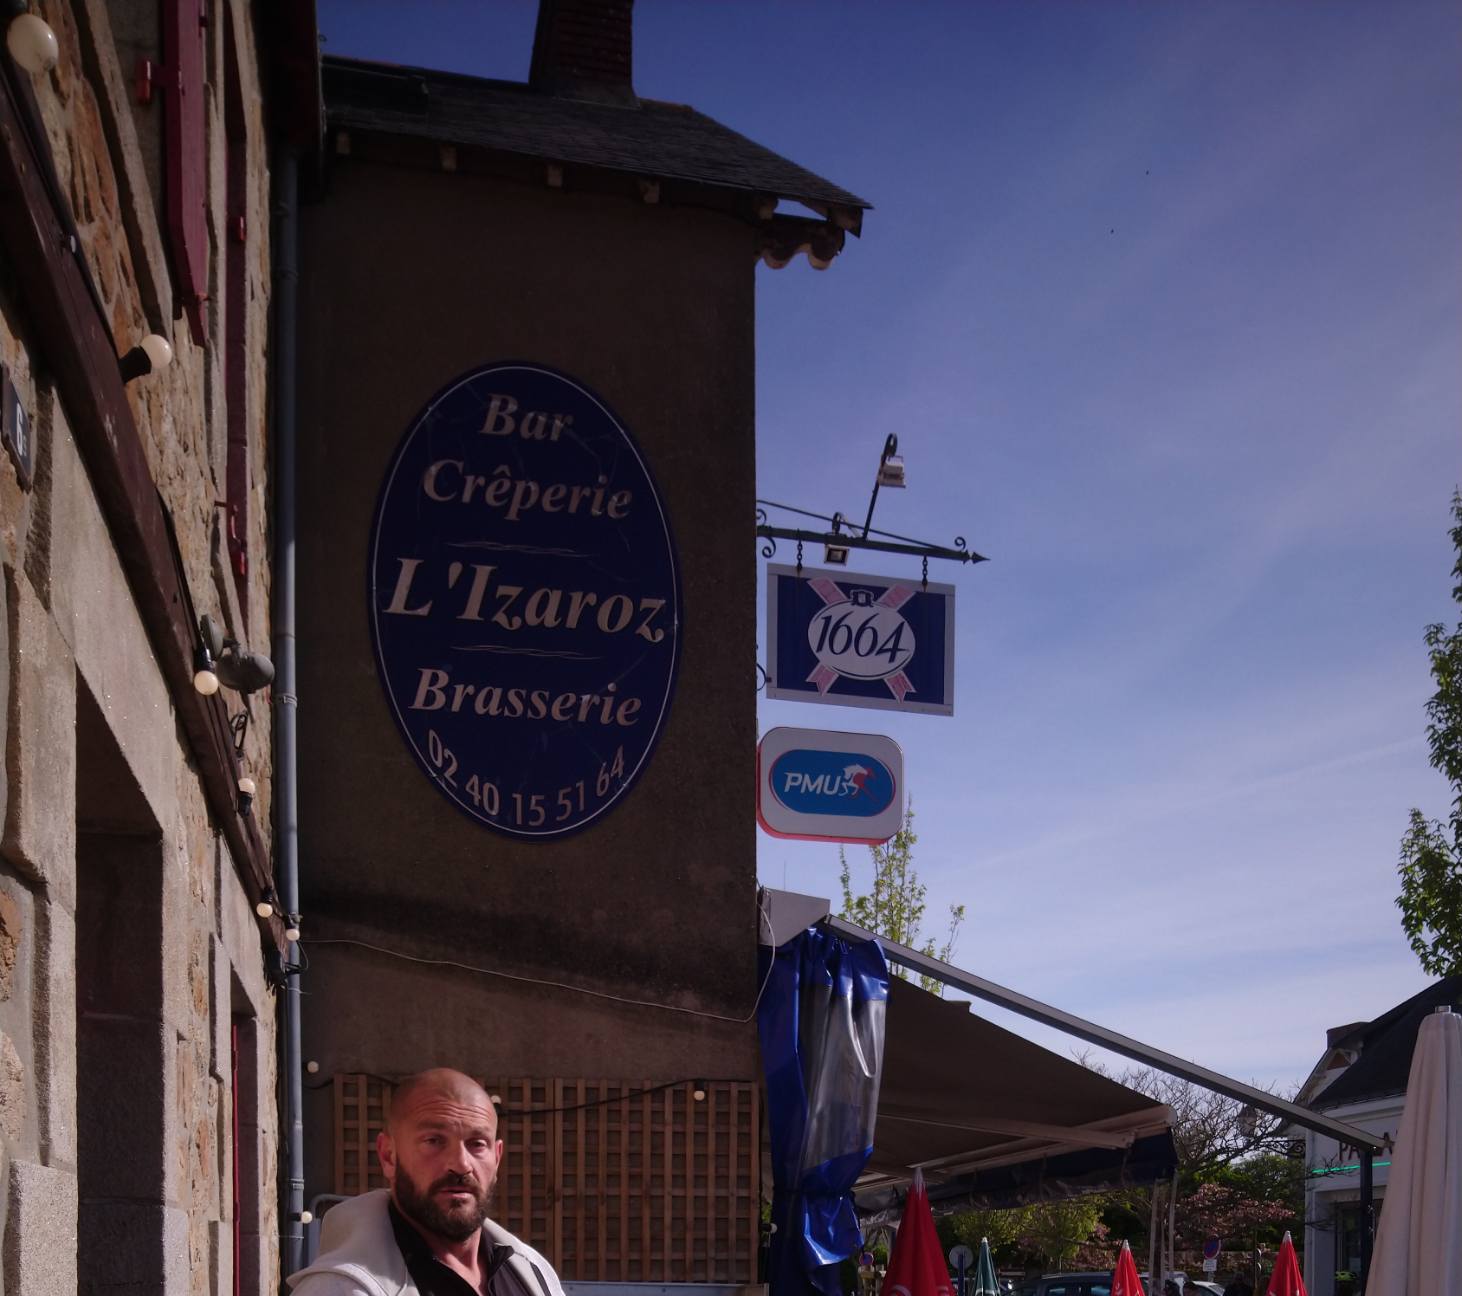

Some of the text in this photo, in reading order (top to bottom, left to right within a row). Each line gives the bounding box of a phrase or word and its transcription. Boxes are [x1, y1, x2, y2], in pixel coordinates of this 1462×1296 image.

[480, 393, 574, 442] Bar
[423, 458, 633, 521] Crêperie
[383, 556, 667, 644] L'Izaroz
[816, 610, 910, 664] 1664
[409, 666, 642, 728] Brasserie
[428, 728, 625, 827] 02 40 15 51 64
[783, 771, 842, 796] PMU
